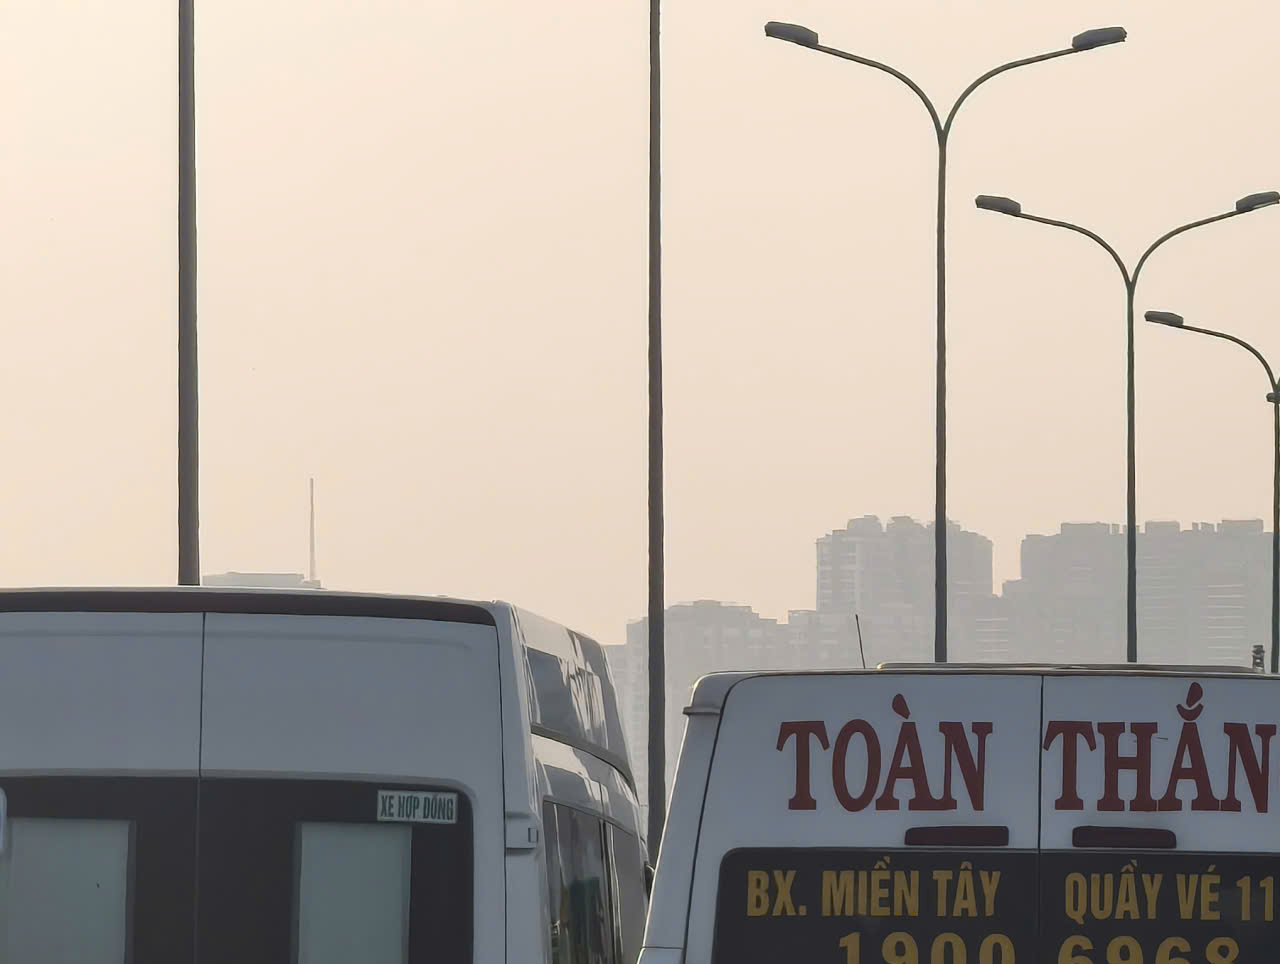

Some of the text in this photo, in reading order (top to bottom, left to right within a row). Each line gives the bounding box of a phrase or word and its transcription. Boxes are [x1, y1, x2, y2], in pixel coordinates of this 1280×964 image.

[776, 693, 994, 812] TOÀN
[380, 795, 395, 817] XE
[747, 856, 1001, 917] BX. MIỀN TÂY
[1065, 859, 1163, 925] QUẦY
[1176, 864, 1221, 921] VÉ
